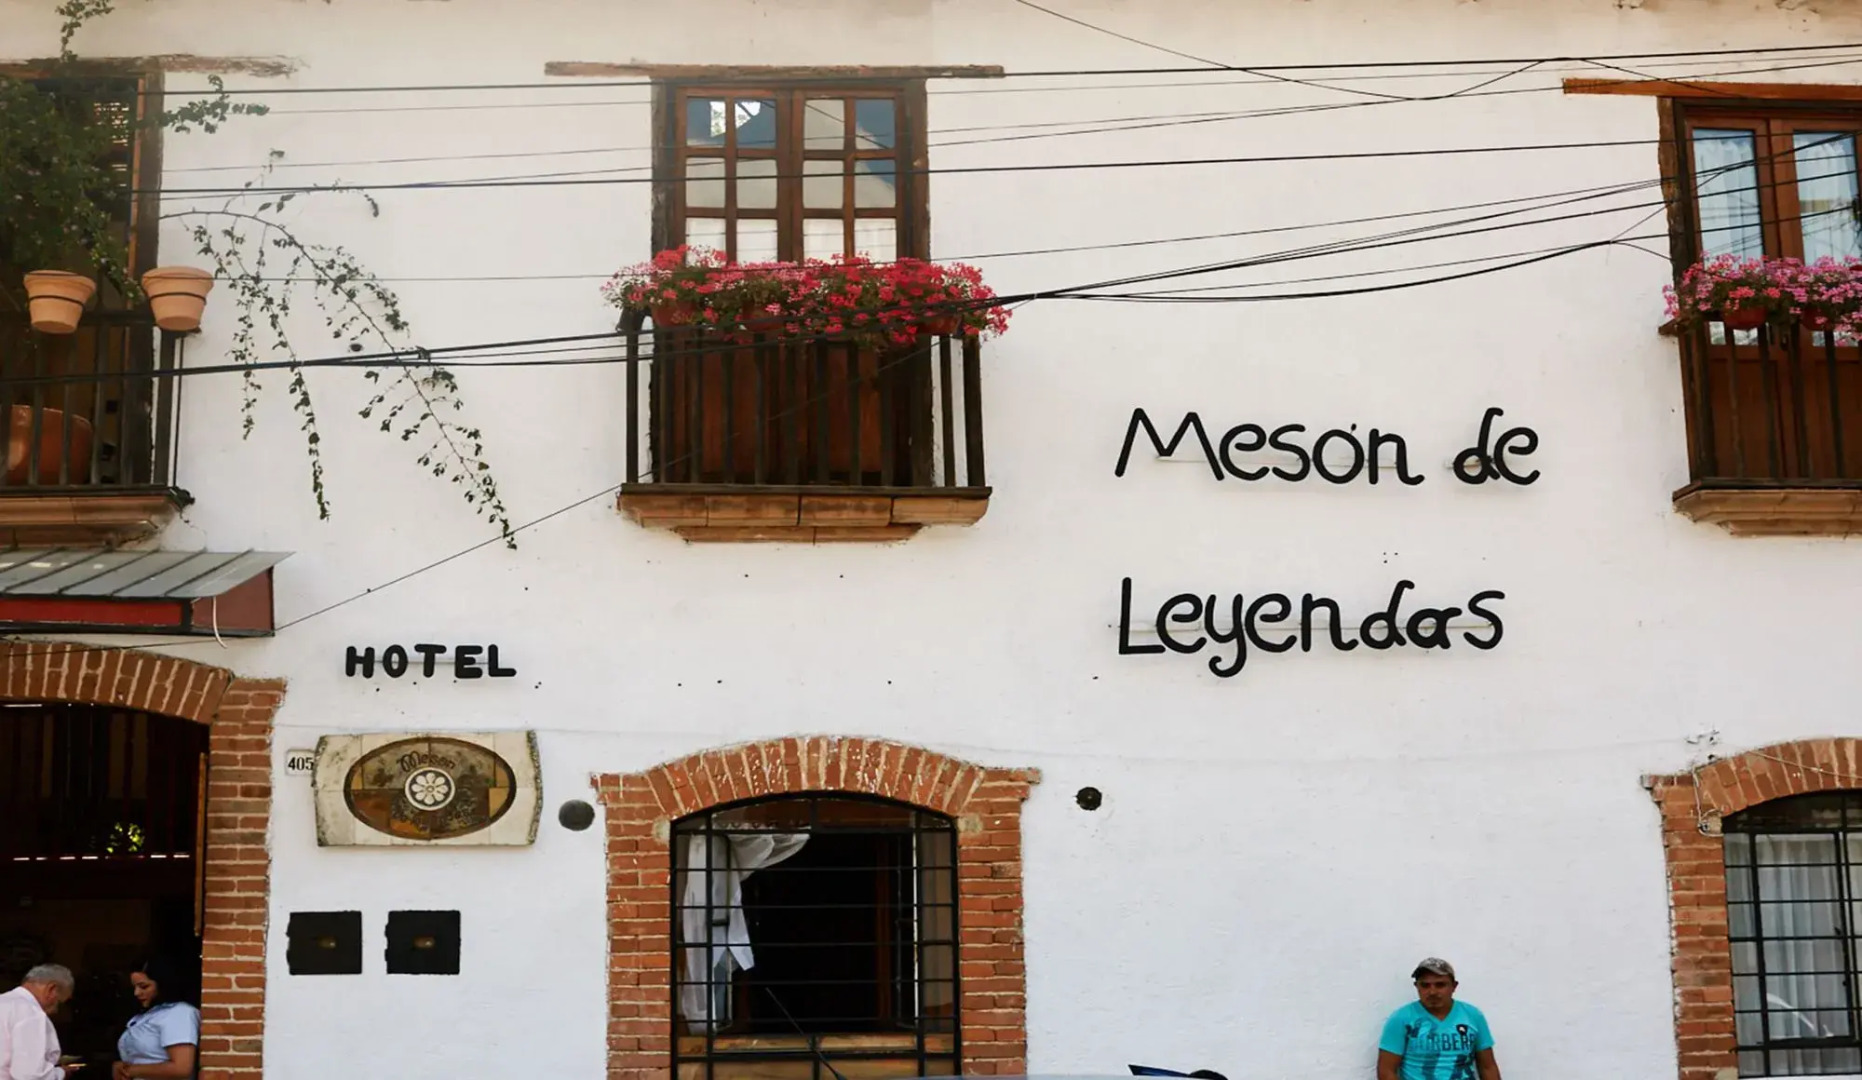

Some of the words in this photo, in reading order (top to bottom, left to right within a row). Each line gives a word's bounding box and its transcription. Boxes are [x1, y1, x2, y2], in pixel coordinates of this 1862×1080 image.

[1452, 407, 1541, 486] de
[1118, 577, 1505, 678] Leyendas
[345, 643, 517, 679] HOTEL
[287, 756, 314, 771] 405
